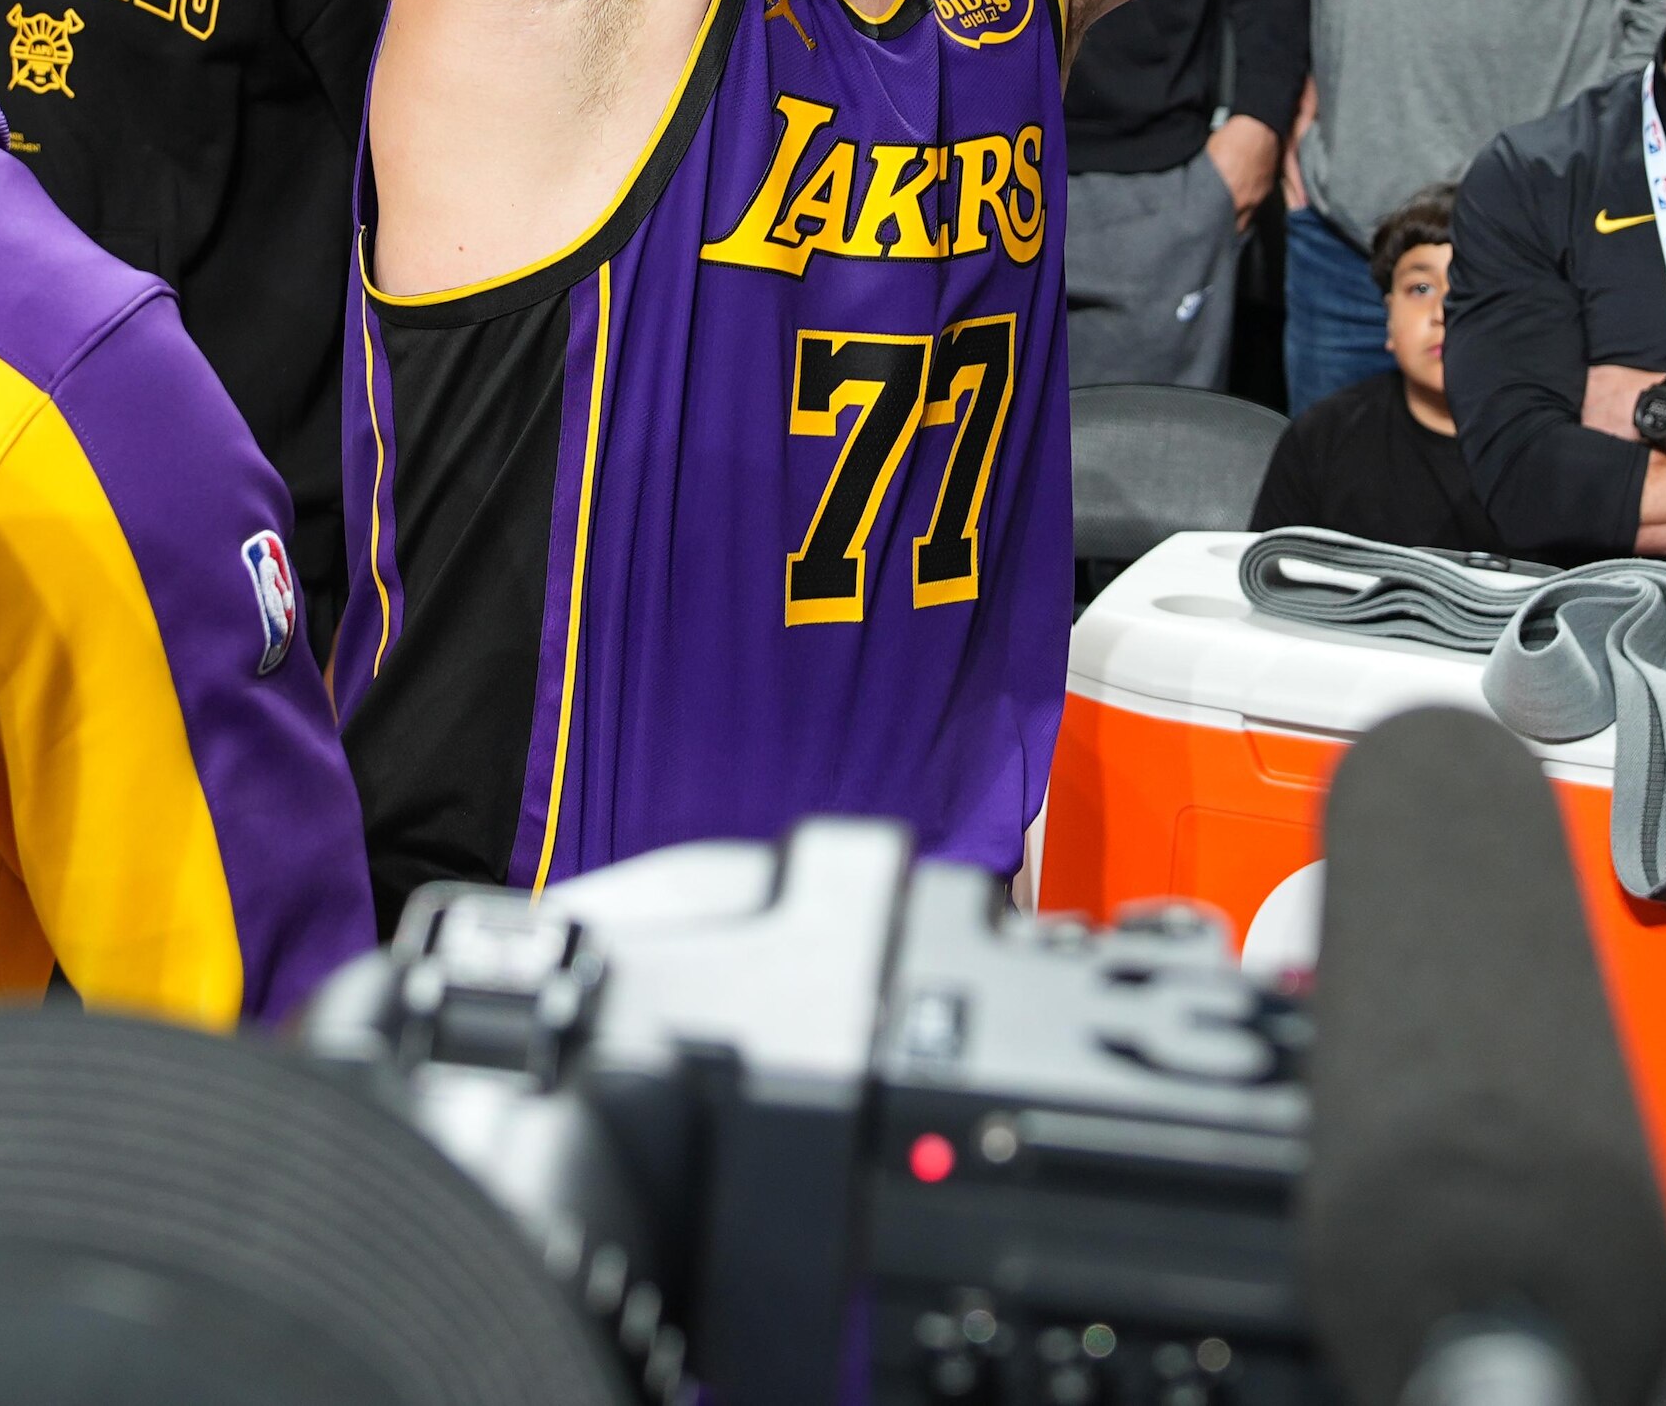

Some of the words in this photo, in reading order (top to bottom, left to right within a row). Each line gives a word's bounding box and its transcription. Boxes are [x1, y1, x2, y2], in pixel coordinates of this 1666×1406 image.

[959, 6, 1001, 29] 비비고
[699, 92, 1048, 282] LAKERS
[784, 312, 1017, 628] 77
